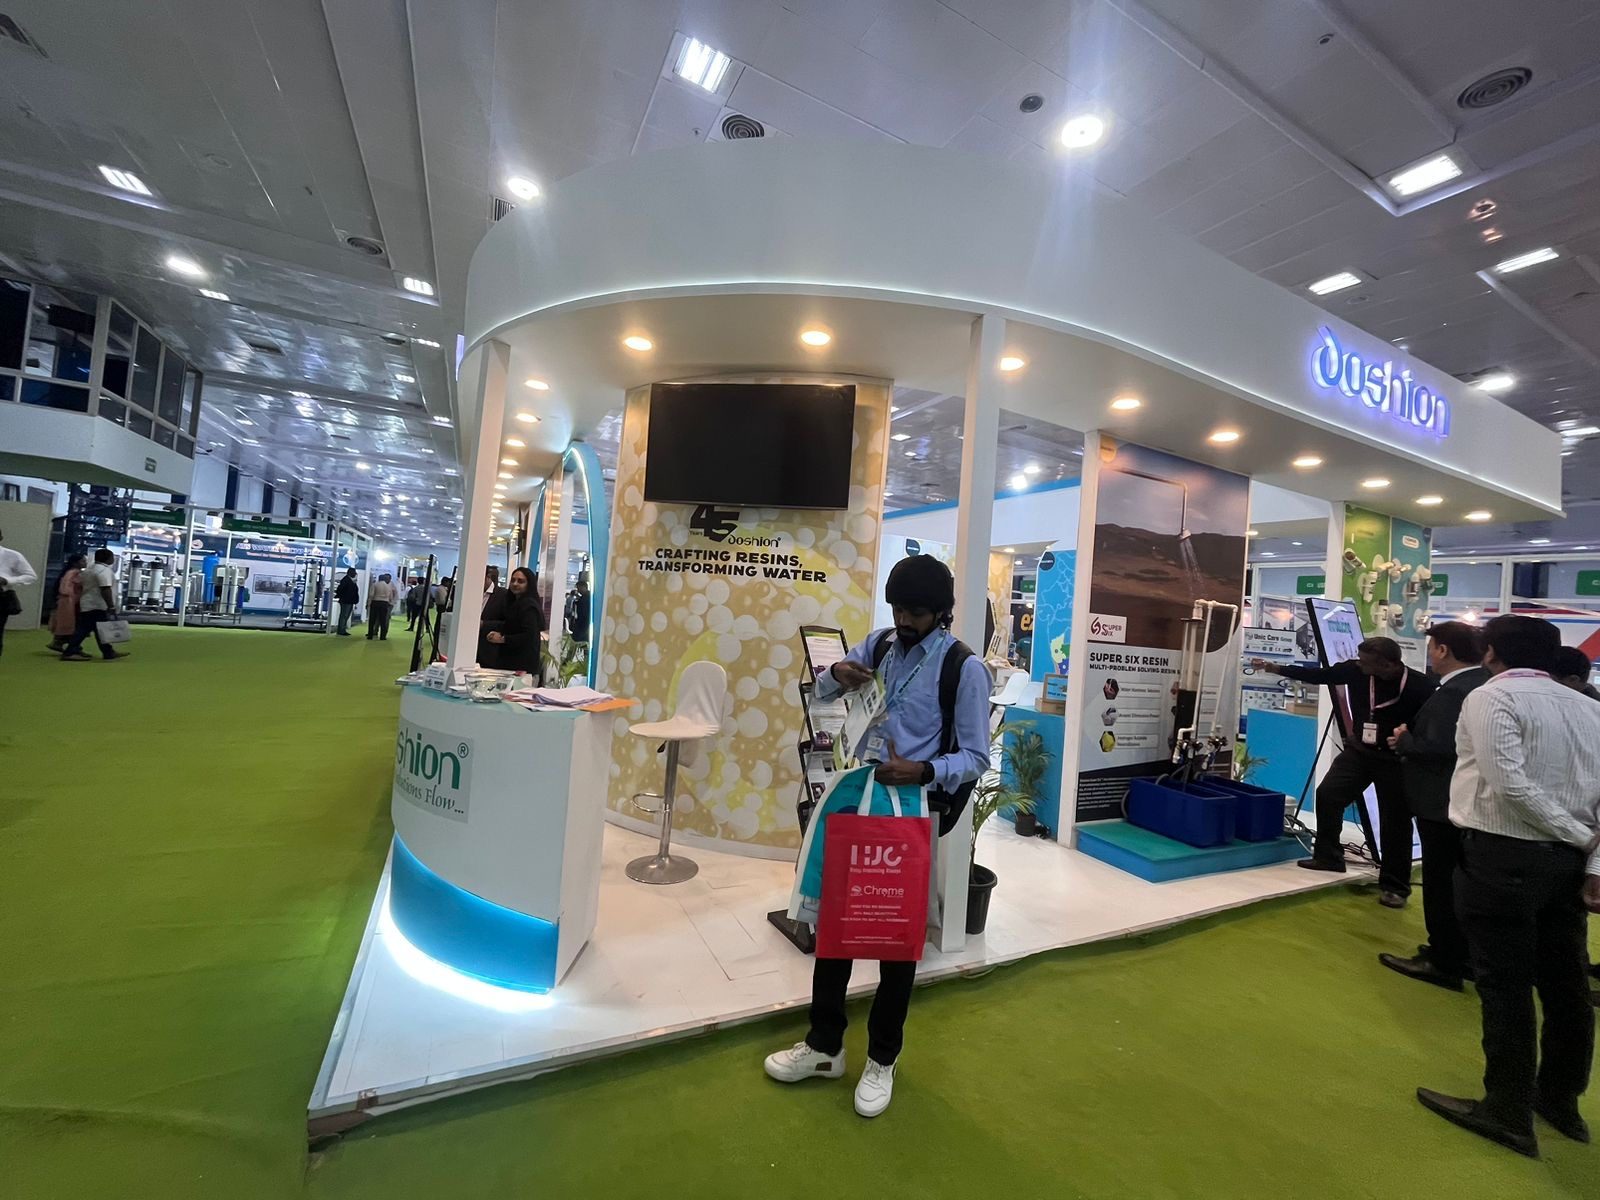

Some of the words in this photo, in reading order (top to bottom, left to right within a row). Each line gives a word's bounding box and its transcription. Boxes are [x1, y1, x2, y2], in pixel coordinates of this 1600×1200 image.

[1311, 326, 1450, 437] doshion
[690, 504, 740, 542] 45
[655, 548, 730, 562] CRAFTING
[735, 551, 803, 569] RESINS,
[638, 560, 758, 577] TRANSFORMING
[763, 567, 826, 583] WATER
[1089, 652, 1123, 664] SUPER
[1125, 655, 1140, 665] SIX
[1142, 656, 1169, 667] RESIN
[1089, 663, 1137, 672] MULTI-PROBLEM
[863, 885, 905, 897] Chrome
